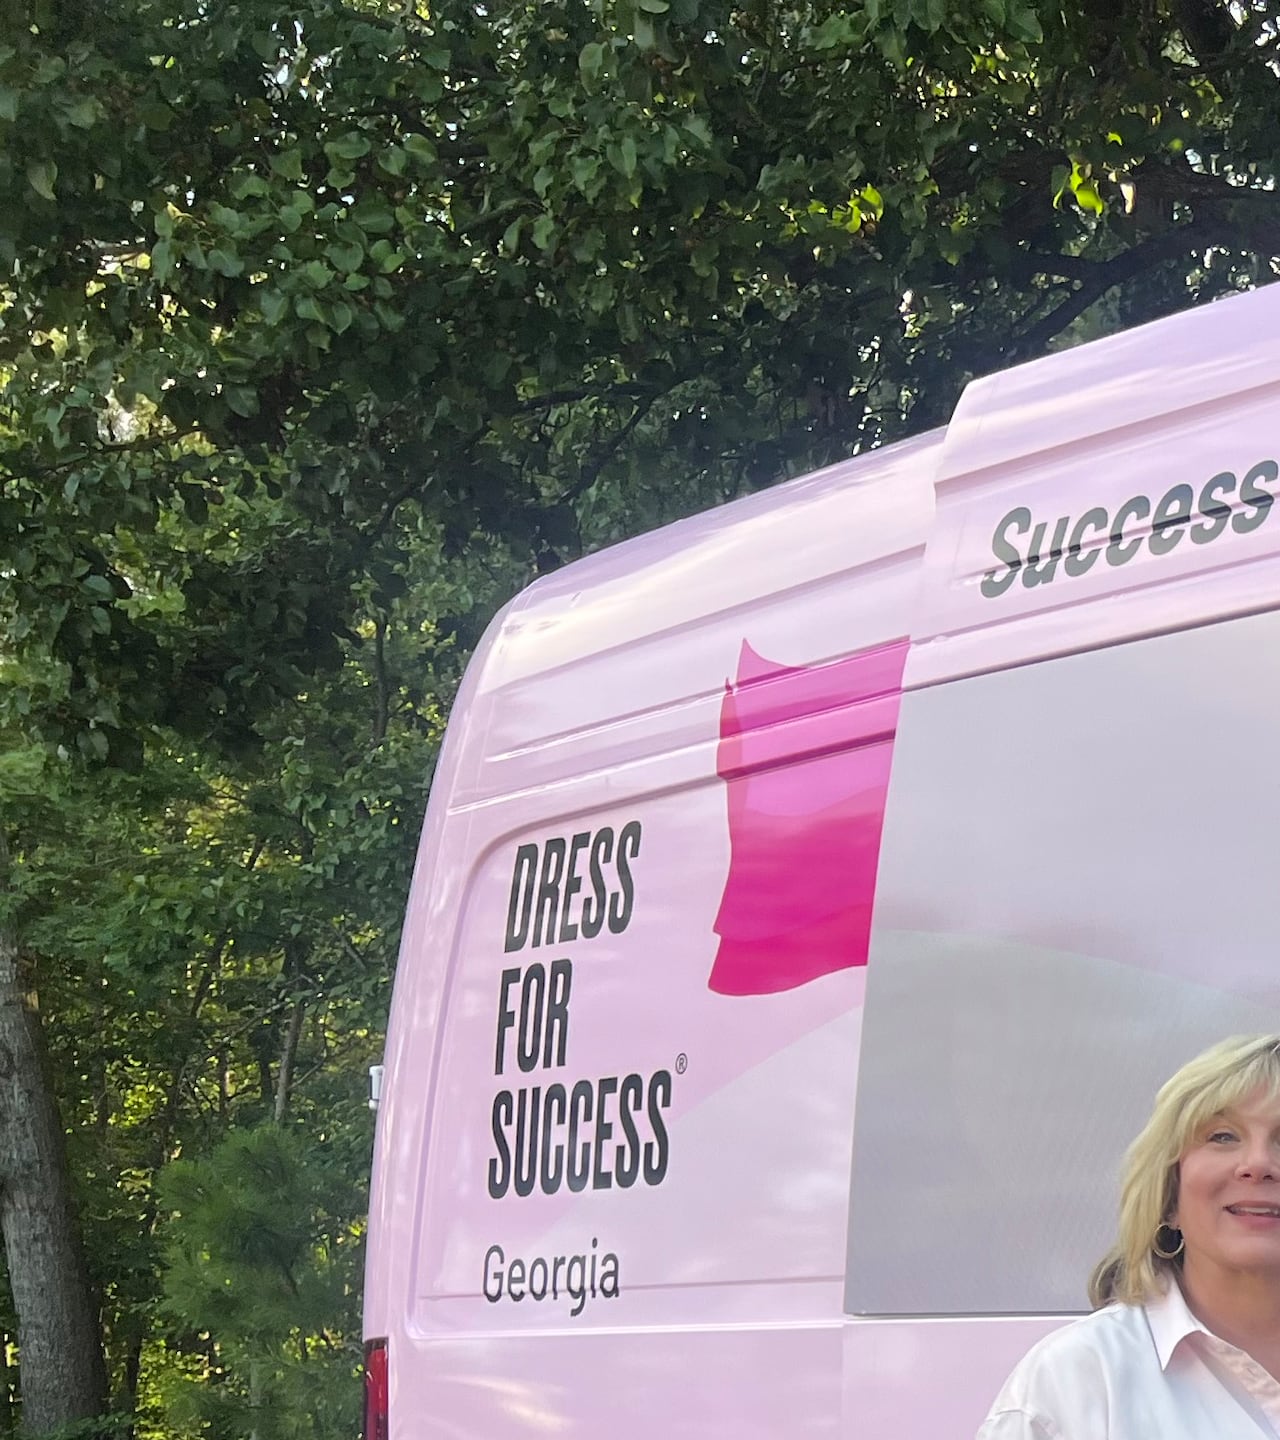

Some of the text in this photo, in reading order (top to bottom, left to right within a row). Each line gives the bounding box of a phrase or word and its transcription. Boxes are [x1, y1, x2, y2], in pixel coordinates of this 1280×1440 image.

[980, 459, 1279, 599] Success
[504, 820, 642, 954] DRESS
[494, 958, 573, 1076] FOR
[482, 1244, 620, 1318] Georgia
